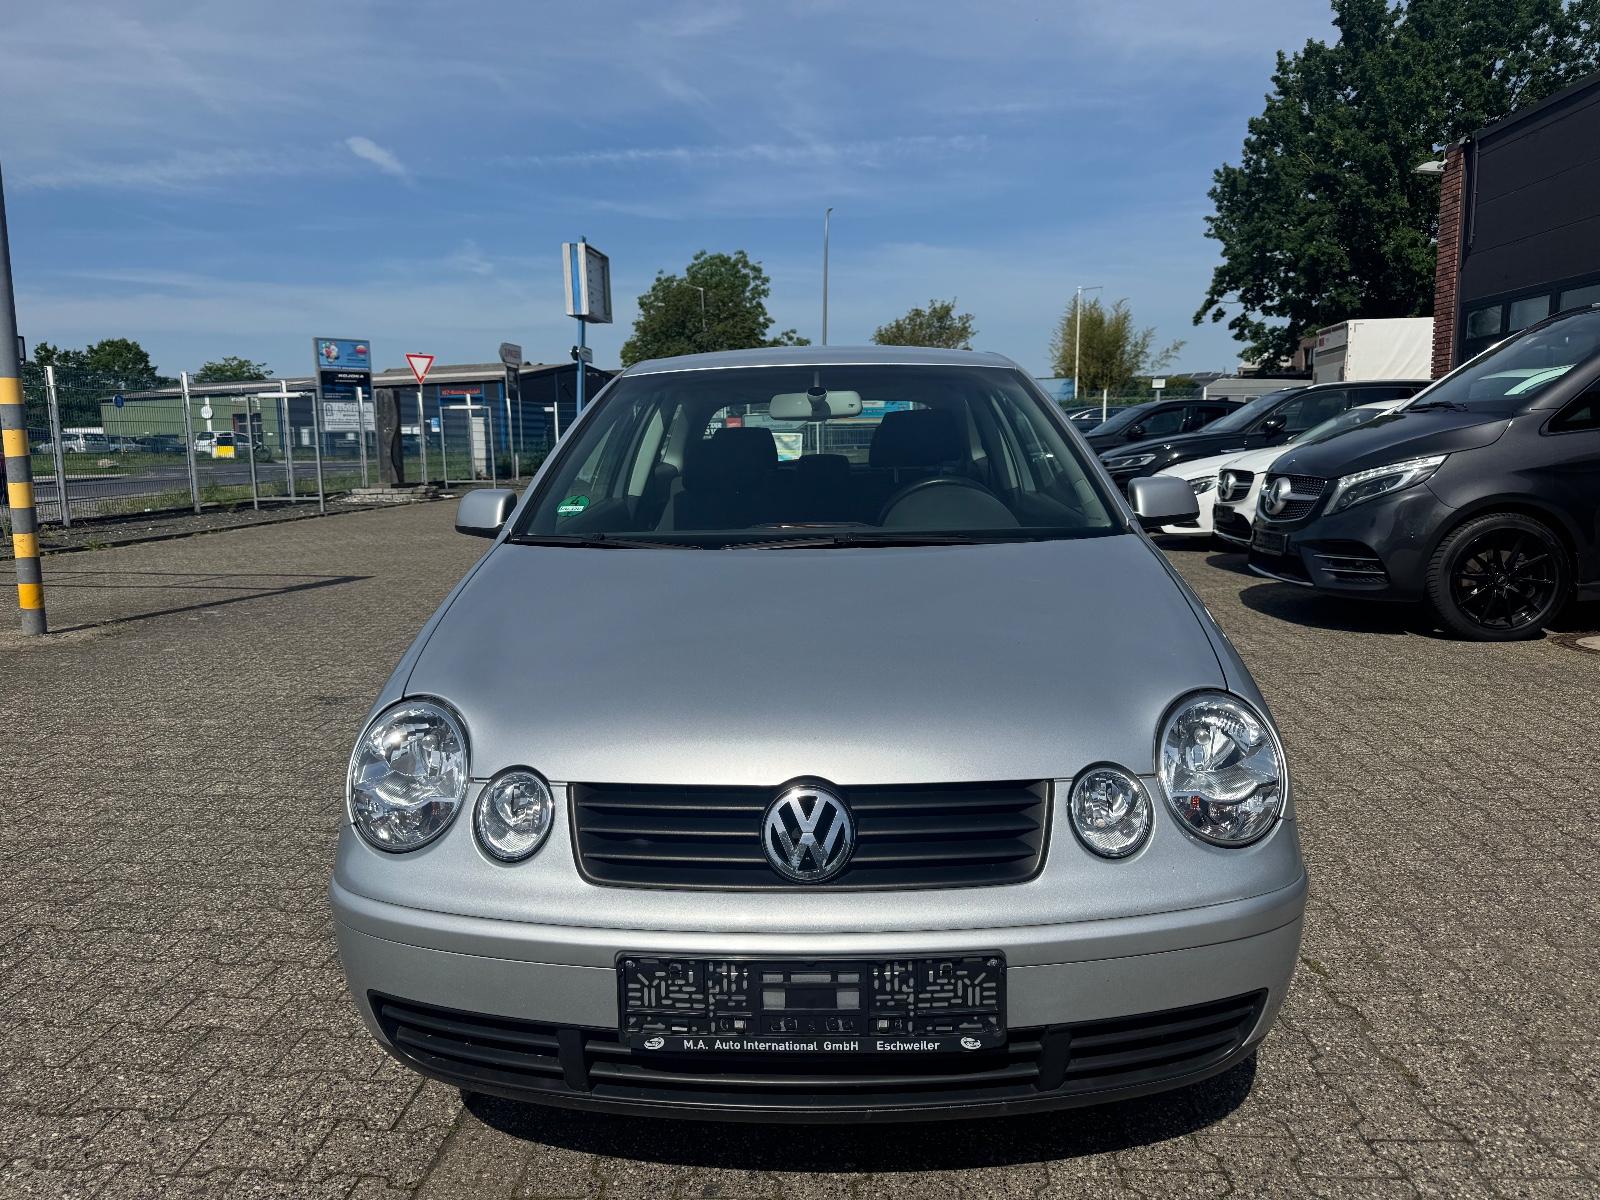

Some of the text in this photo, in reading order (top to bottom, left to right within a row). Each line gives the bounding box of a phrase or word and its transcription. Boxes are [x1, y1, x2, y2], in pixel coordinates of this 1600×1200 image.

[762, 785, 854, 881] VW
[683, 1039, 941, 1051] M.A. Auto International GmbH Eschweiler
